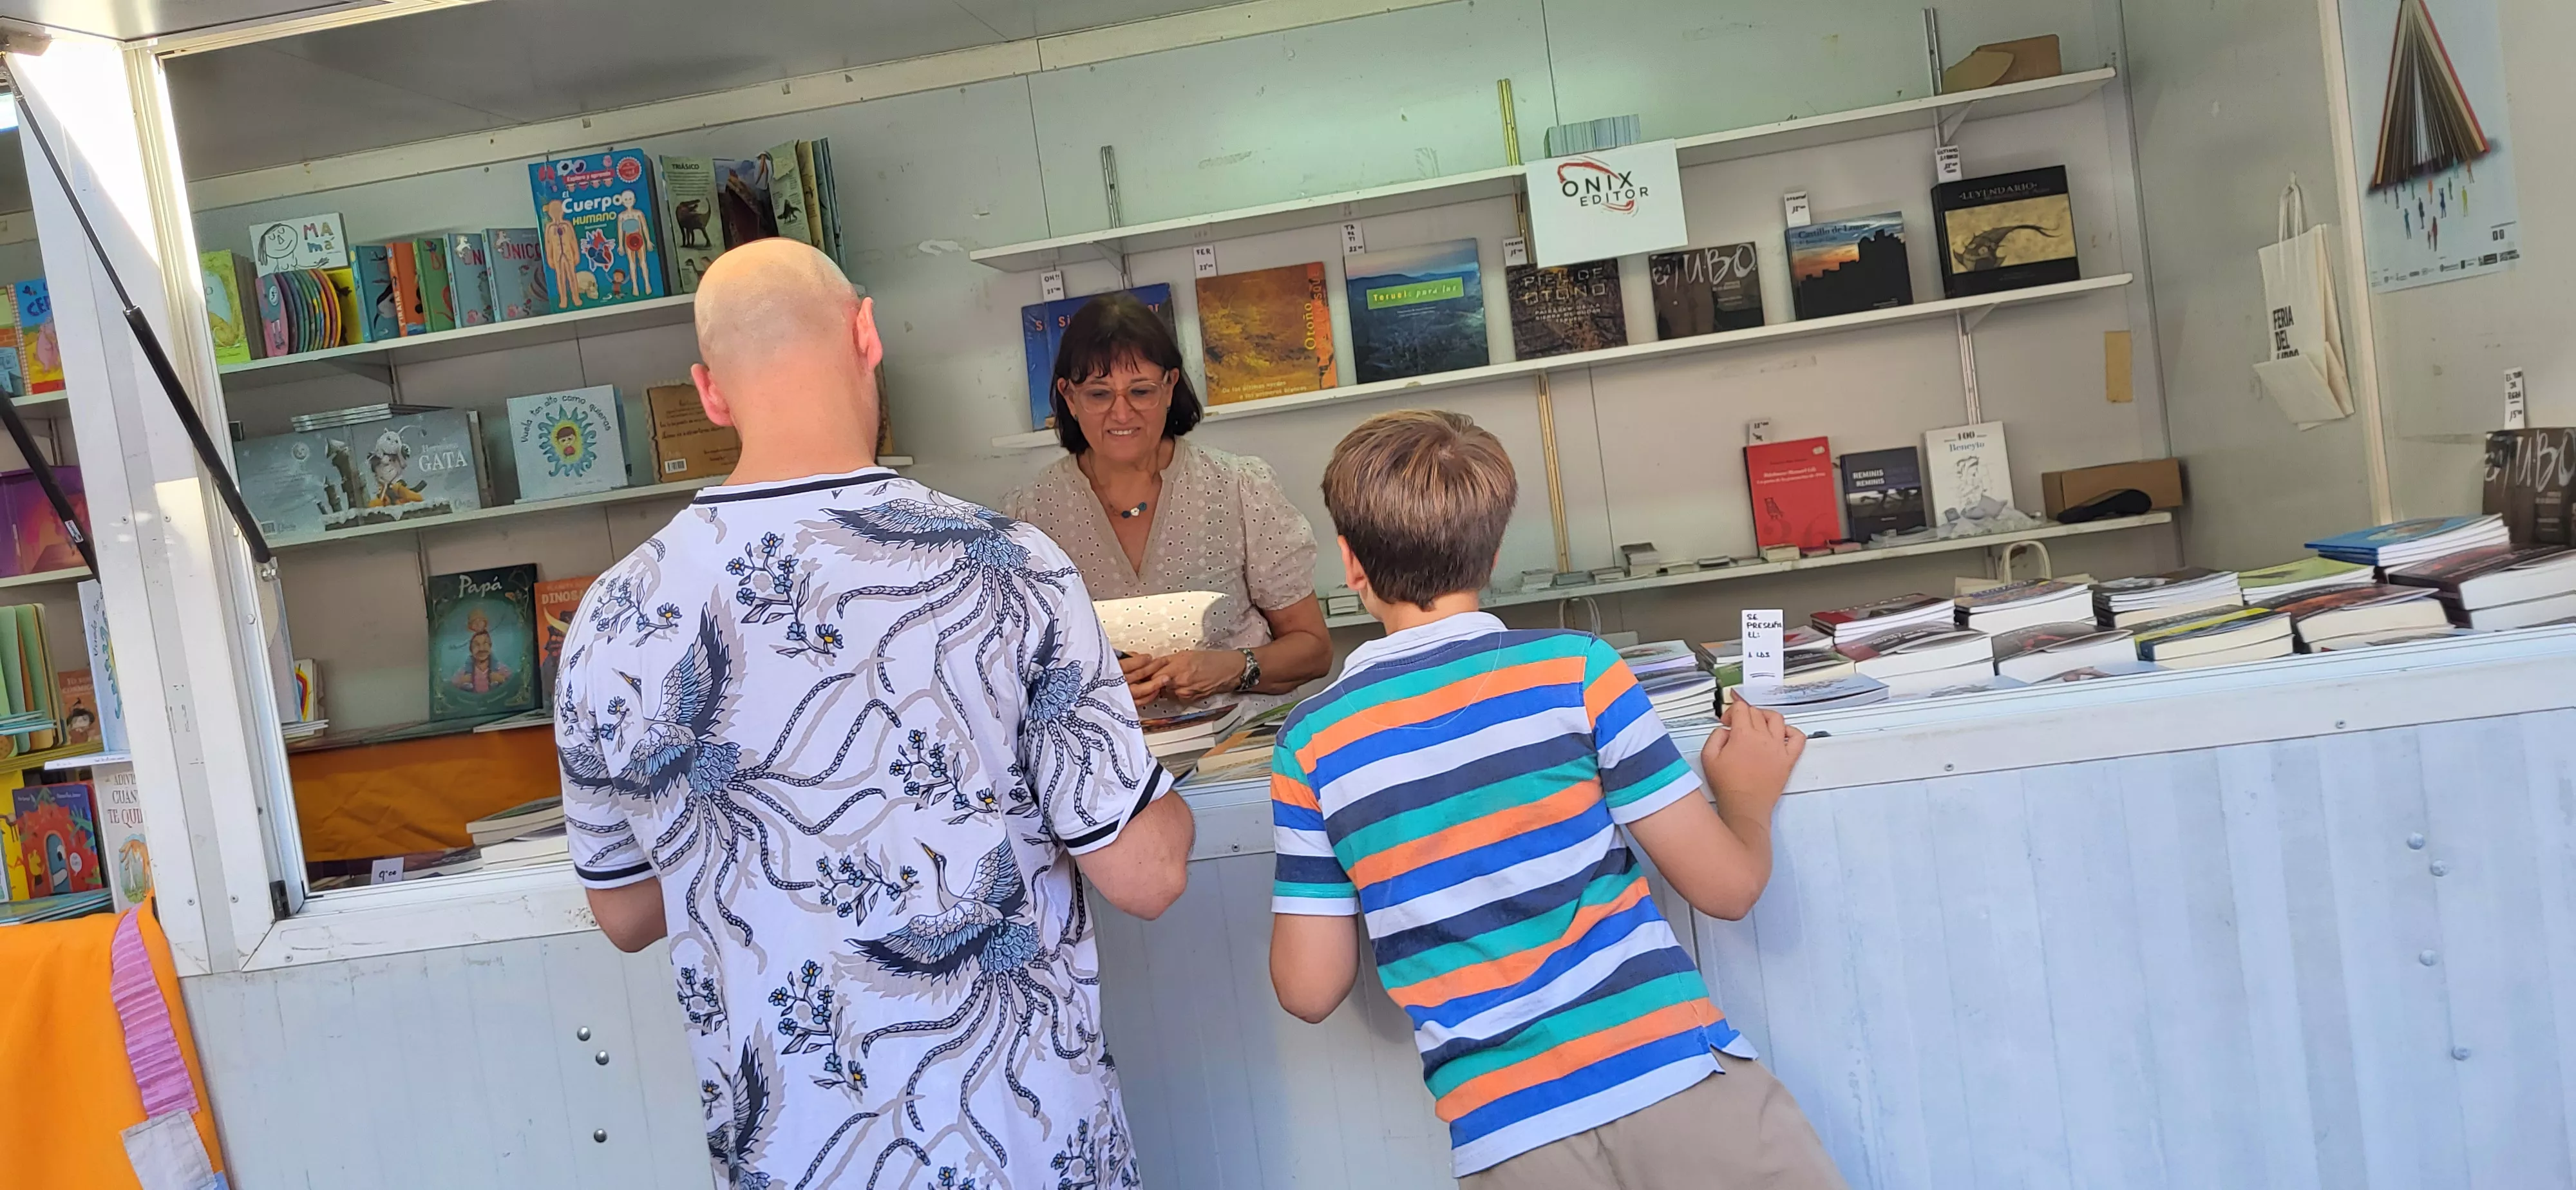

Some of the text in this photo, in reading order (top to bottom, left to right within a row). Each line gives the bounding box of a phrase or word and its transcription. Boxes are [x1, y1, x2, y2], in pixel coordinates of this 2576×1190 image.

[562, 190, 569, 198] El
[1562, 171, 1634, 197] ONIX
[562, 194, 622, 214] Cuerpo
[1580, 187, 1649, 207] EDITOR
[573, 211, 617, 225] HUMANO
[303, 222, 334, 240] MA
[1578, 267, 1604, 281] DE
[1302, 302, 1316, 350] Otoño
[2273, 305, 2295, 330] FERIA
[2275, 331, 2291, 352] DEL
[520, 394, 611, 444] Vuela tan alto como quieras
[418, 450, 468, 473] GATA
[1852, 469, 1884, 480] REMINIS
[1855, 477, 1885, 487] REMINIS
[458, 574, 502, 598] Papá
[108, 809, 119, 824] TE
